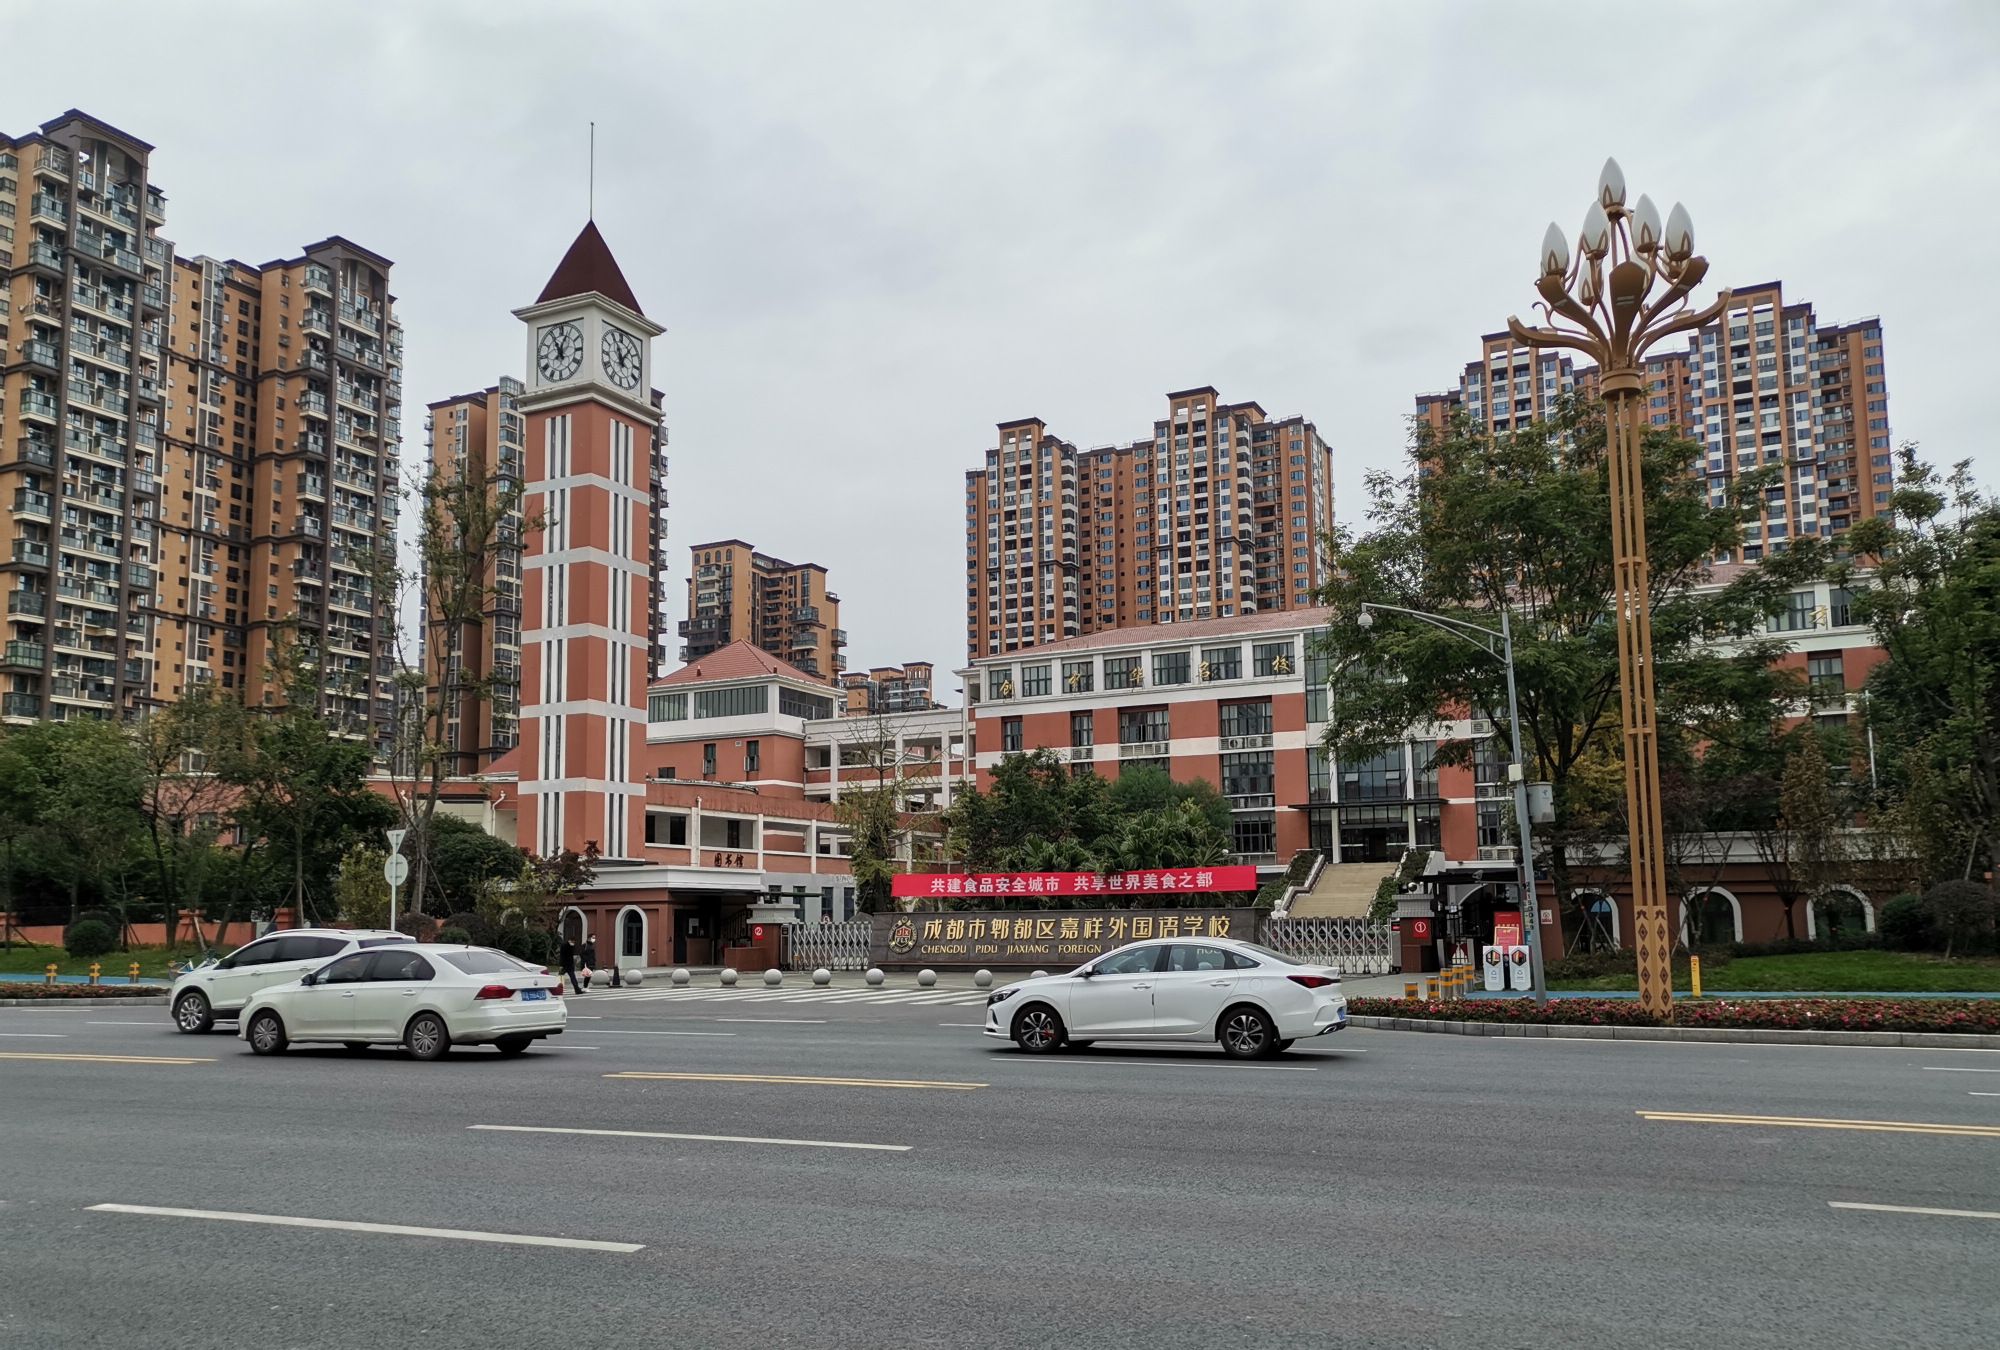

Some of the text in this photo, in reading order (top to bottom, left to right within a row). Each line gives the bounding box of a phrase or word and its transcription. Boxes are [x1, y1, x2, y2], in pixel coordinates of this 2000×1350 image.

[931, 871, 1213, 893] 共建食品安全城市 共享世界美食之都
[923, 915, 1230, 940] 成都市郫都区嘉祥外国语学校
[921, 944, 967, 954] CHENGDU
[975, 944, 998, 954] PIDU
[1006, 944, 1049, 955] JIAXIANG
[1058, 944, 1102, 954] FOREIGN
